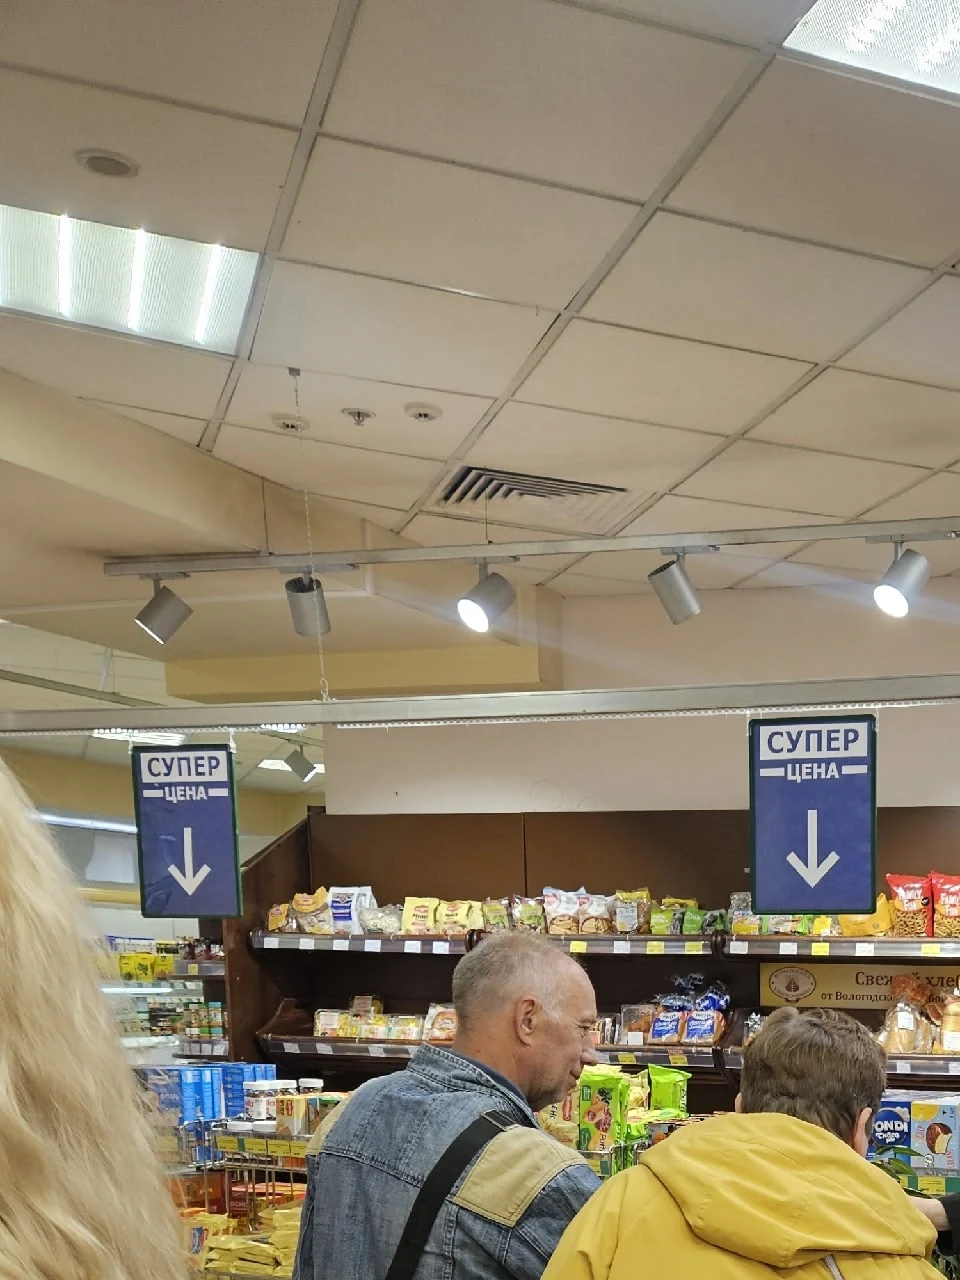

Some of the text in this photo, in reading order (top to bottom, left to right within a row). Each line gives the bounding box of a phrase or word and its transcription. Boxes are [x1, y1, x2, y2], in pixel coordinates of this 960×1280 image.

[767, 728, 860, 754] СУПЕР
[146, 755, 221, 777] СУПЕР
[786, 762, 840, 783] ЦЕНА
[164, 785, 208, 803] ЦЕНА
